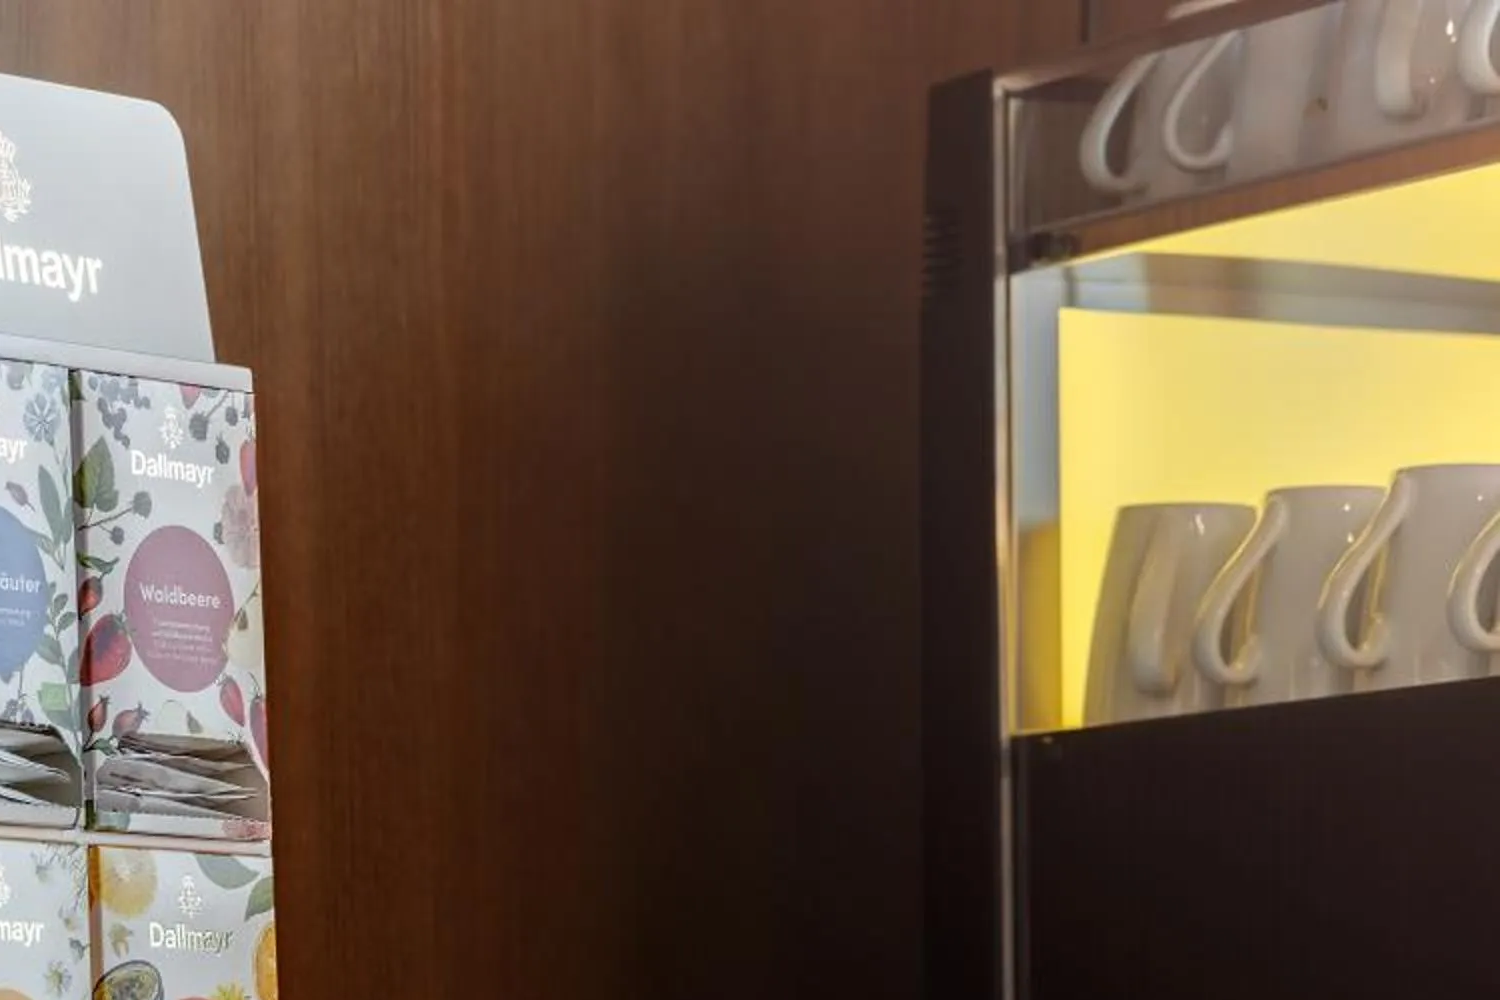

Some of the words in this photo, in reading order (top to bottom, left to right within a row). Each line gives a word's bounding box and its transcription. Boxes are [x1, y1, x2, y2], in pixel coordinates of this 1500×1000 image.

[131, 451, 215, 487] Dallmayr
[140, 583, 221, 610] Waldbeere
[149, 922, 234, 954] Dallmayr
